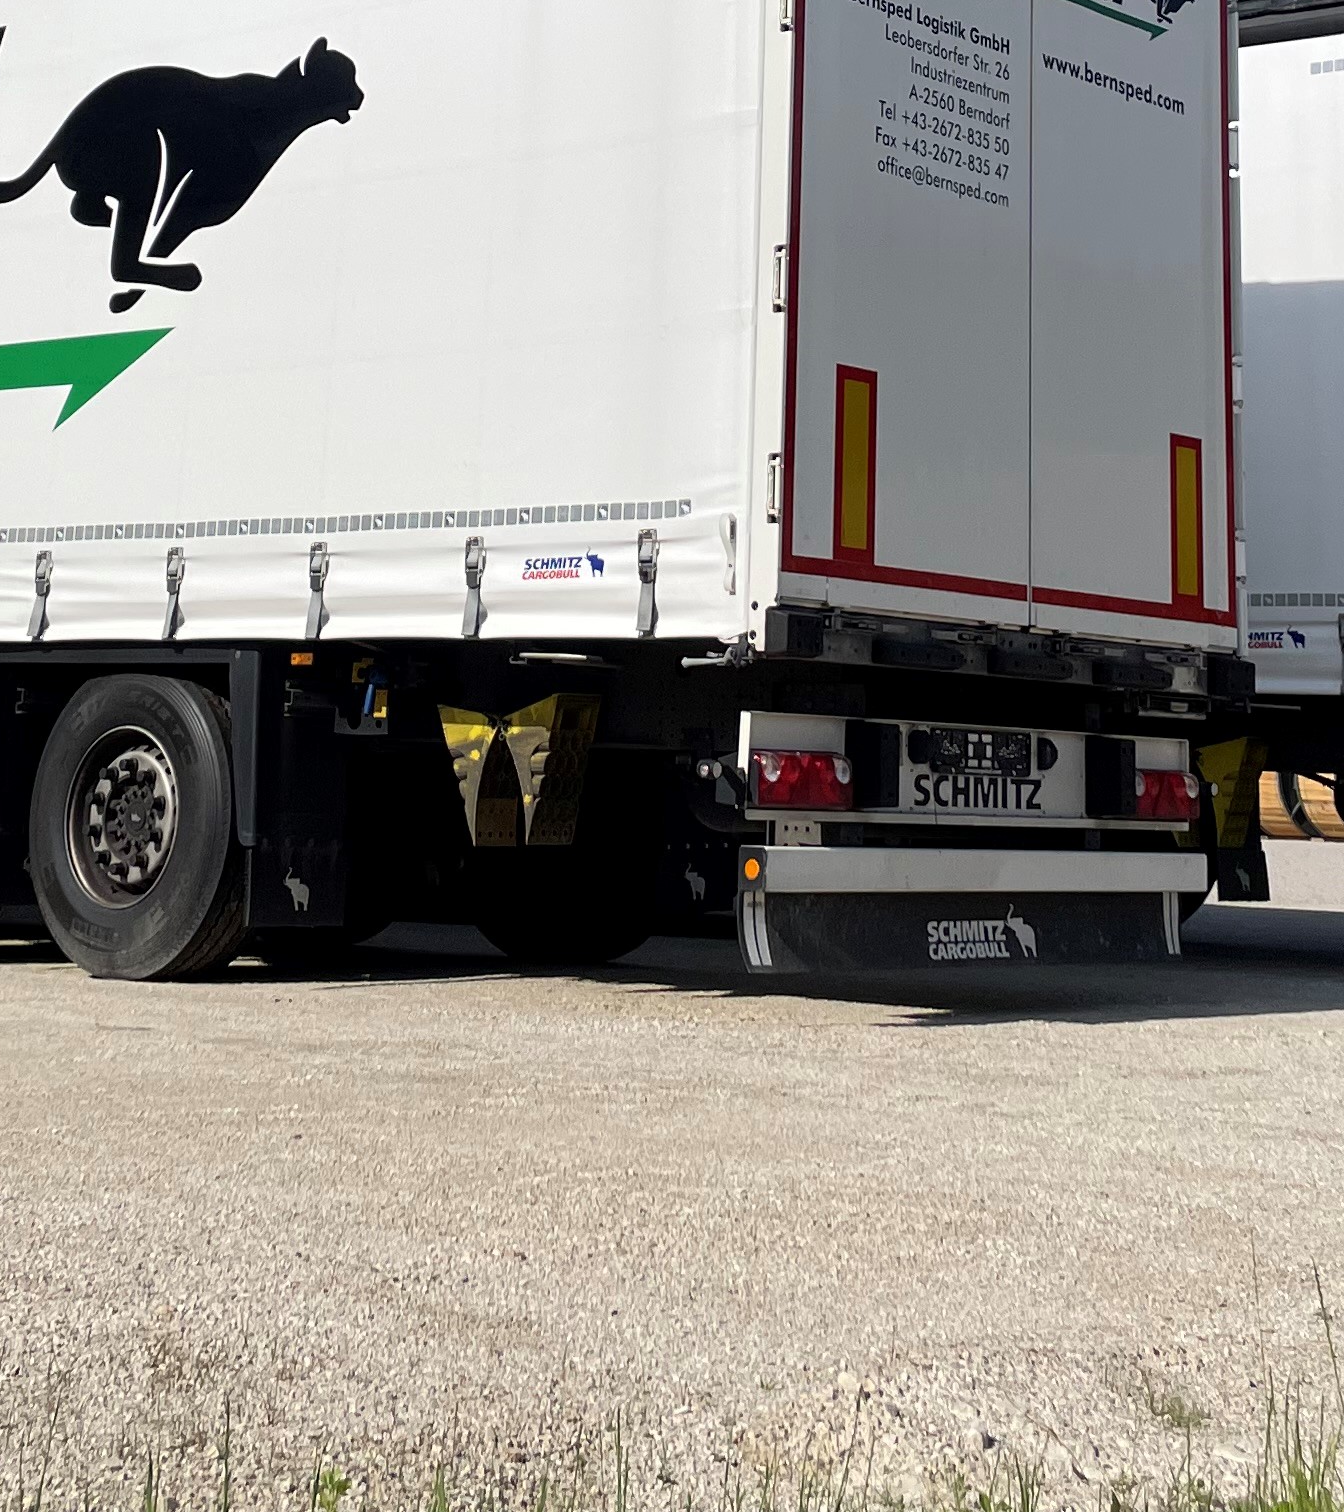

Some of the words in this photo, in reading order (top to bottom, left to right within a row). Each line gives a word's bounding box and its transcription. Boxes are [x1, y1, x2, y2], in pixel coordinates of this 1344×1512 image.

[885, 23, 969, 67] Leobersdorfer
[973, 53, 991, 75] Str.
[995, 61, 1010, 80] 26
[916, 7, 966, 39] Logistik
[969, 27, 1010, 55] GmbH
[910, 56, 1010, 104] Industriezentrum
[1042, 53, 1185, 115] www.bernsped.com
[878, 99, 896, 121] Tel
[902, 110, 990, 150] +43-2672-835
[994, 136, 1010, 156] 50
[909, 84, 955, 112] A-2560
[959, 98, 1010, 129] Berndorf
[875, 126, 897, 148] Fax
[902, 136, 990, 176] +43-2672-835
[995, 163, 1009, 181] 47
[877, 156, 1009, 208] office@bernsped.com
[522, 569, 580, 580] CARGOBULL
[524, 556, 583, 570] SCHMITZ
[1248, 631, 1284, 641] HMITZ
[914, 774, 1042, 809] SCHMITZ
[927, 920, 1006, 943] SCHMITZ
[929, 941, 1010, 961] CARGOBULL
